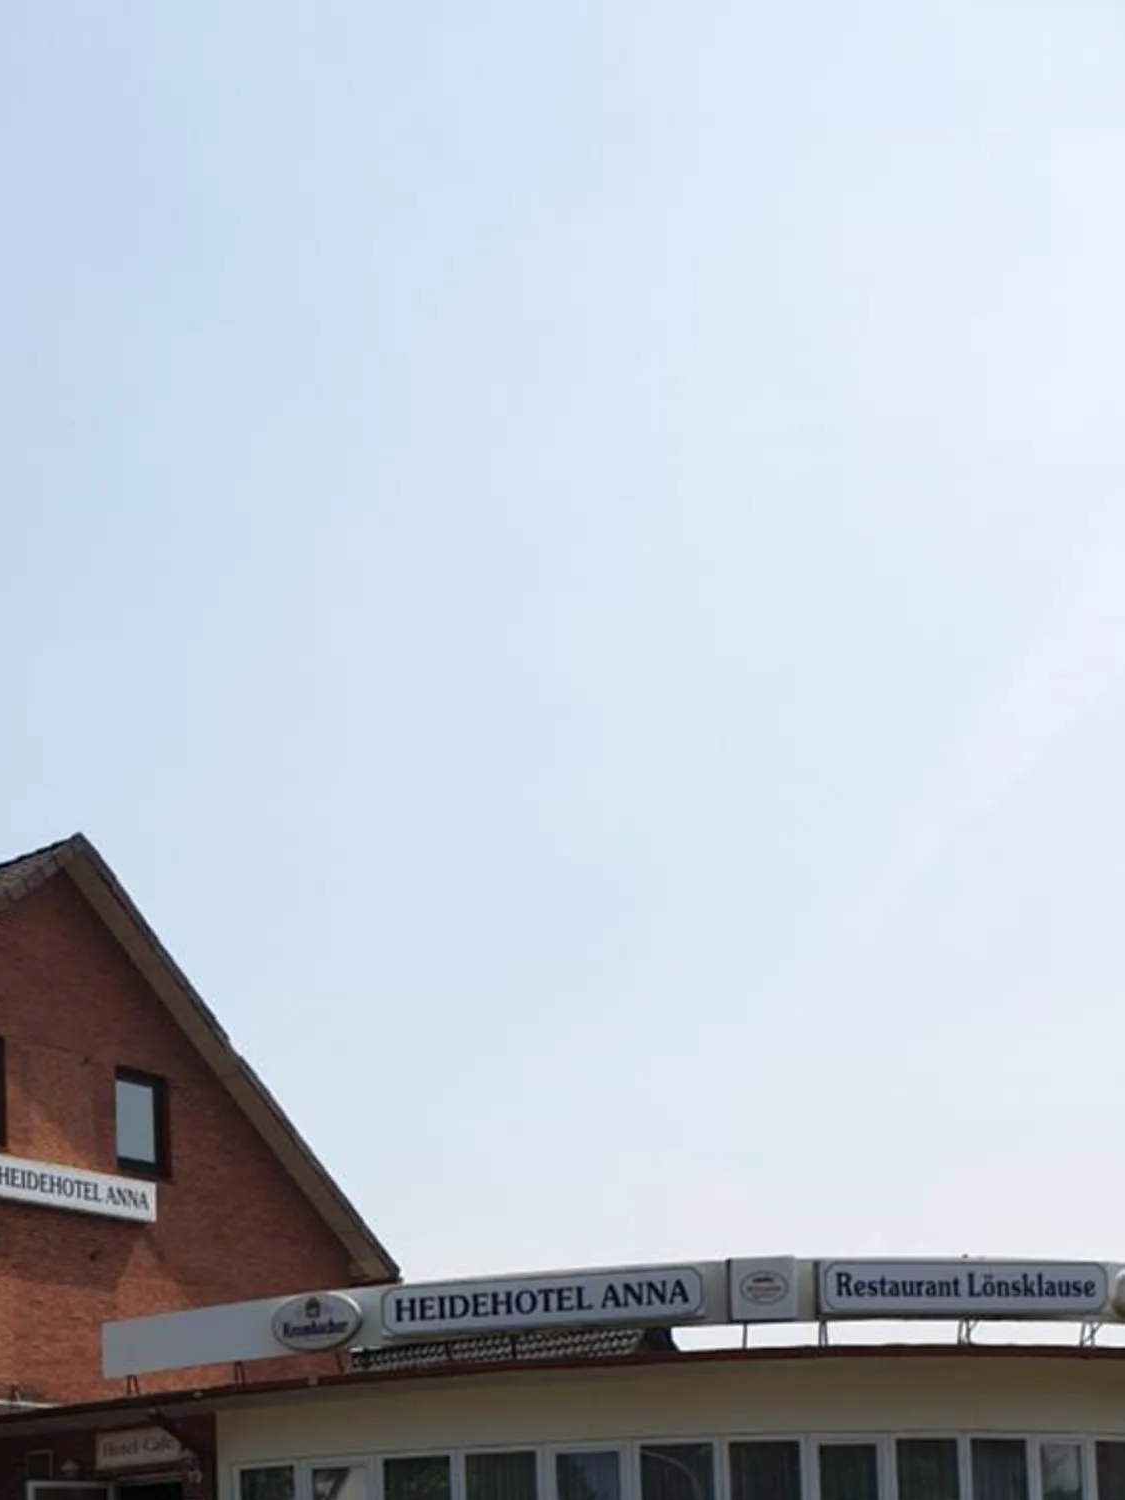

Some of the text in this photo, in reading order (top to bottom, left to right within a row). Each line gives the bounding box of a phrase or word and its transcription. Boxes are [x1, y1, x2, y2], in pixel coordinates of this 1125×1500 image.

[105, 1185, 150, 1211] ANNA
[835, 1272, 1097, 1299] Restaurant Lönsklause
[394, 1278, 691, 1323] HEIDEHOTEL ANNA
